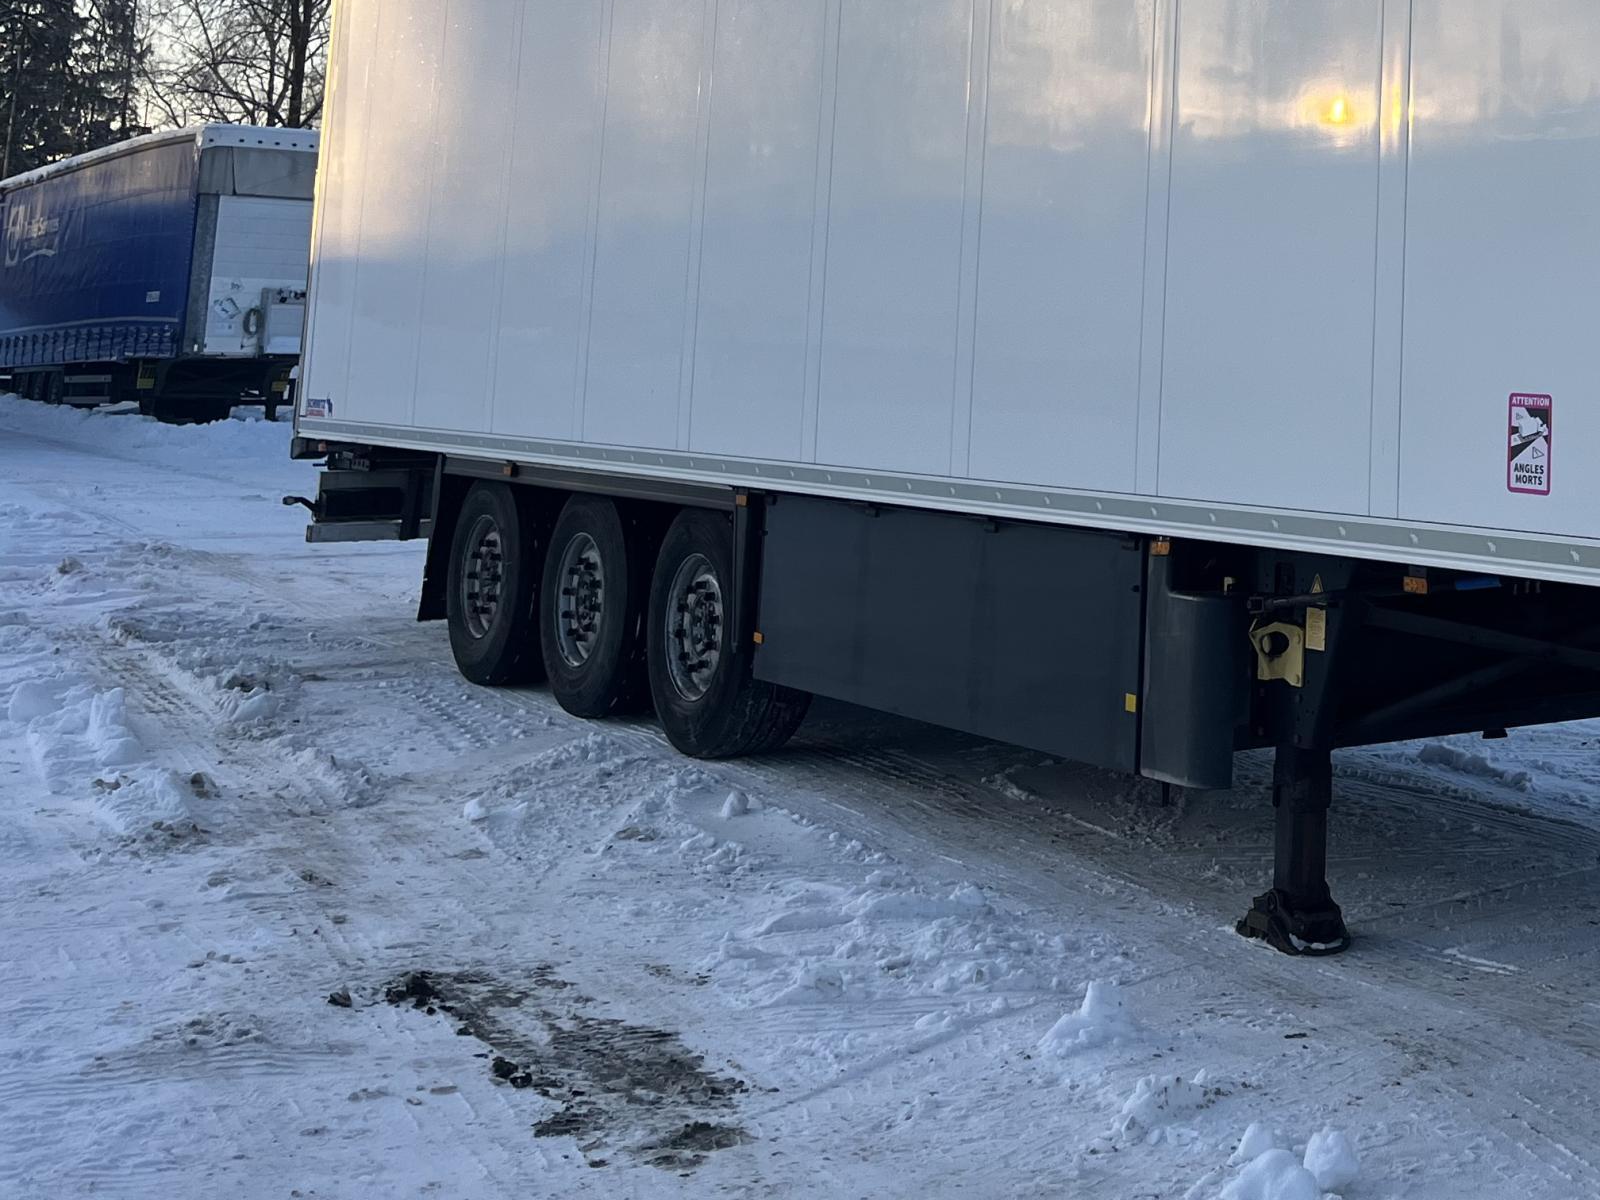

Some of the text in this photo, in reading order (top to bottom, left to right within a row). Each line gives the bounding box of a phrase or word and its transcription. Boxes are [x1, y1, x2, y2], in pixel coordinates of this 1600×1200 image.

[1511, 396, 1550, 407] ATTENTION
[1513, 462, 1545, 475] ANGLES
[1515, 474, 1543, 486] MORTS
